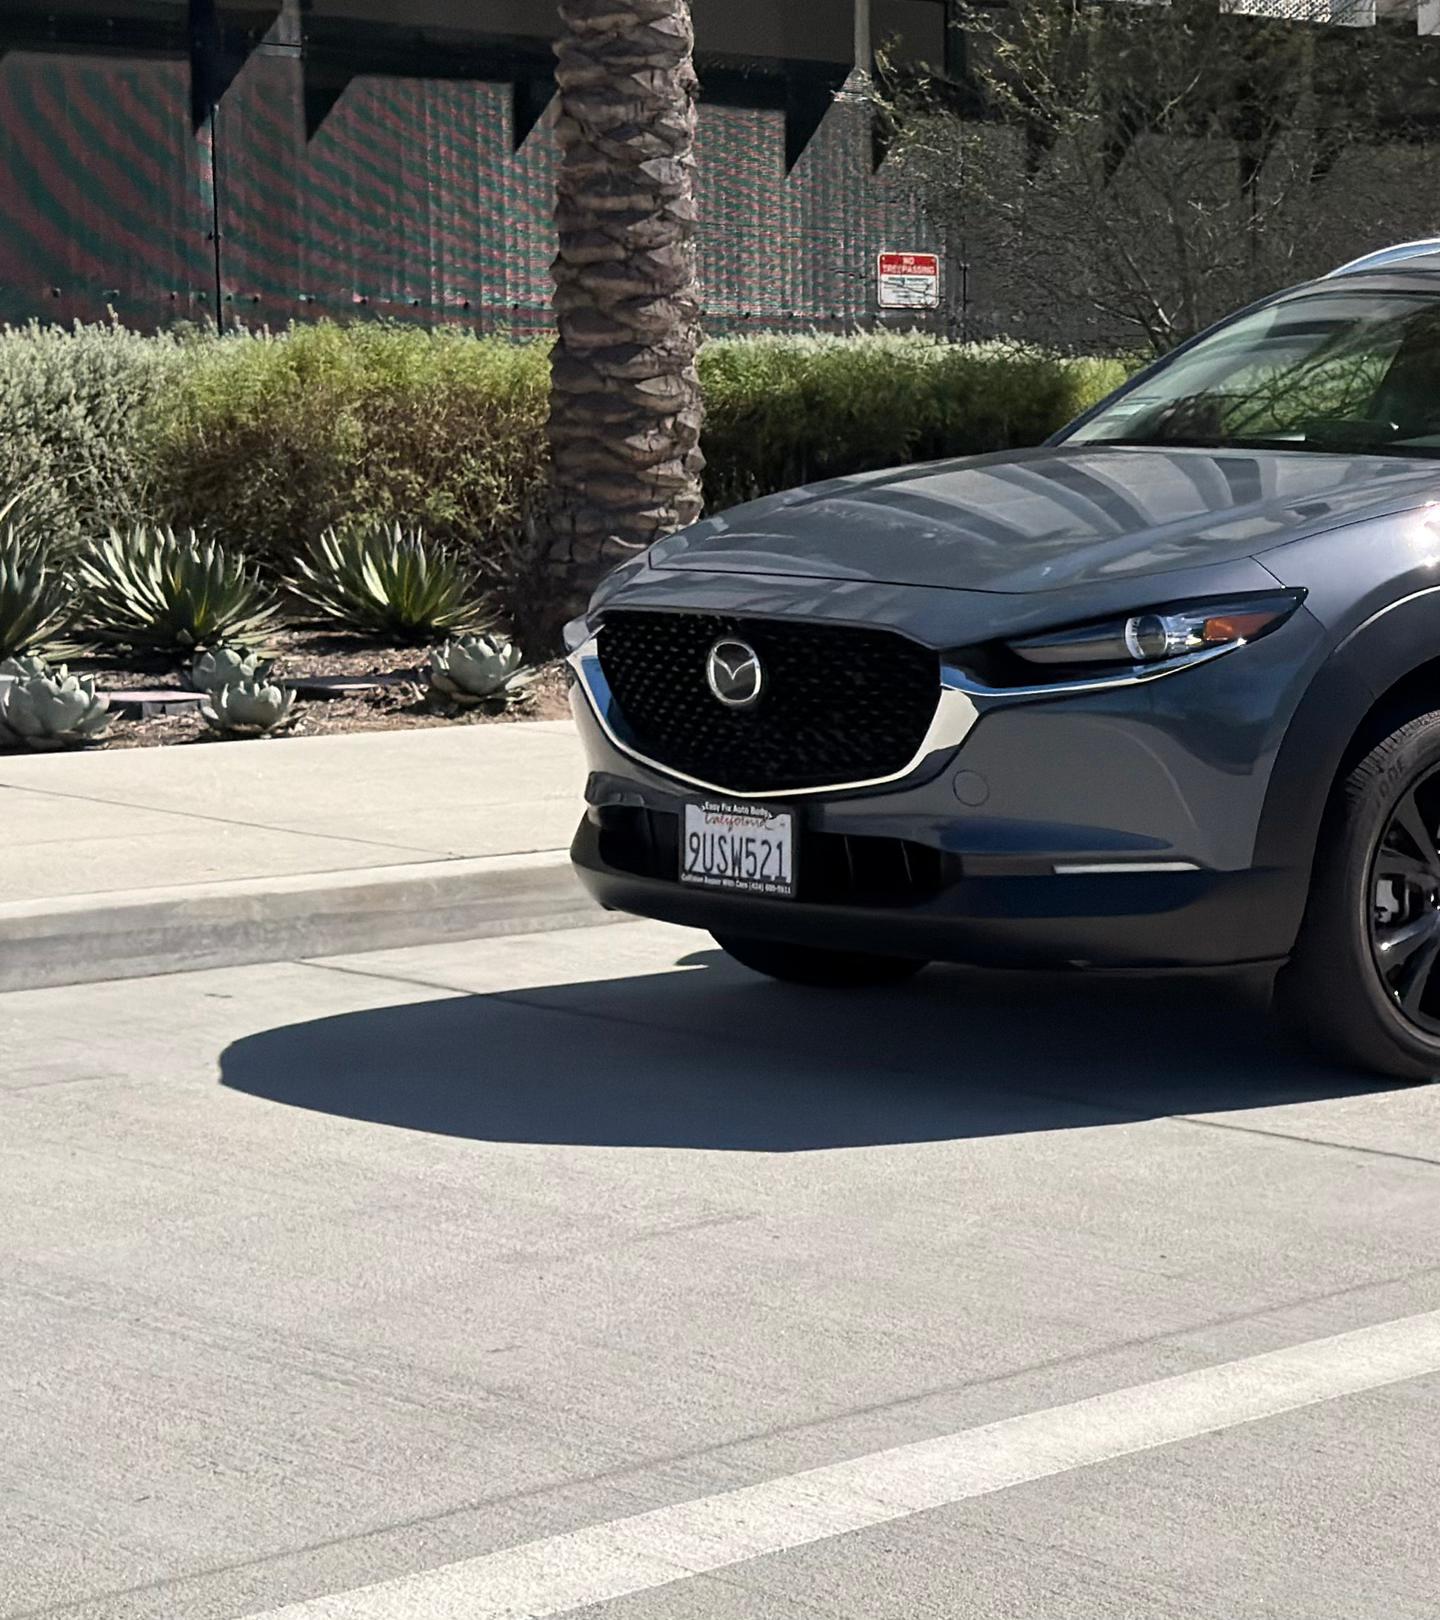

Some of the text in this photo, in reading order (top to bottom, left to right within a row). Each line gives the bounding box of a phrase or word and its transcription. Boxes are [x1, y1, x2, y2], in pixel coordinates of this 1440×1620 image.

[903, 257, 915, 265] NO
[705, 801, 720, 812] Easy
[721, 802, 732, 812] Fix
[733, 804, 750, 814] Auto
[689, 832, 787, 882] 9USW521
